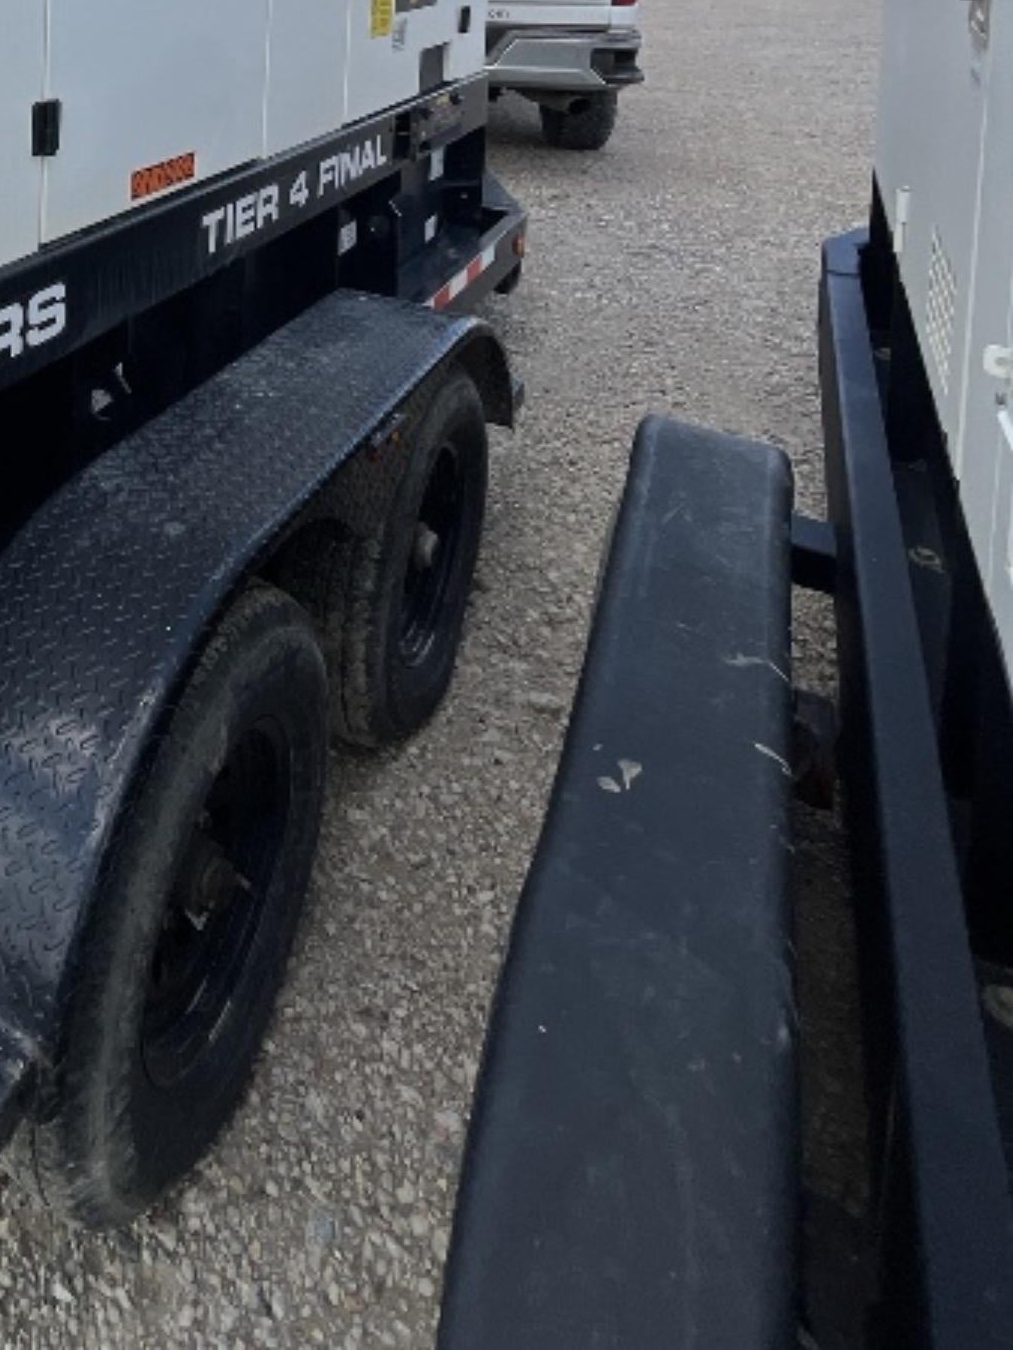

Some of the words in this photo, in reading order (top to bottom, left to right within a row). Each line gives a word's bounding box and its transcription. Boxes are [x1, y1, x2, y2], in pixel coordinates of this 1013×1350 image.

[201, 182, 279, 255] TIER
[289, 170, 309, 208] 4
[317, 134, 387, 199] FINAL
